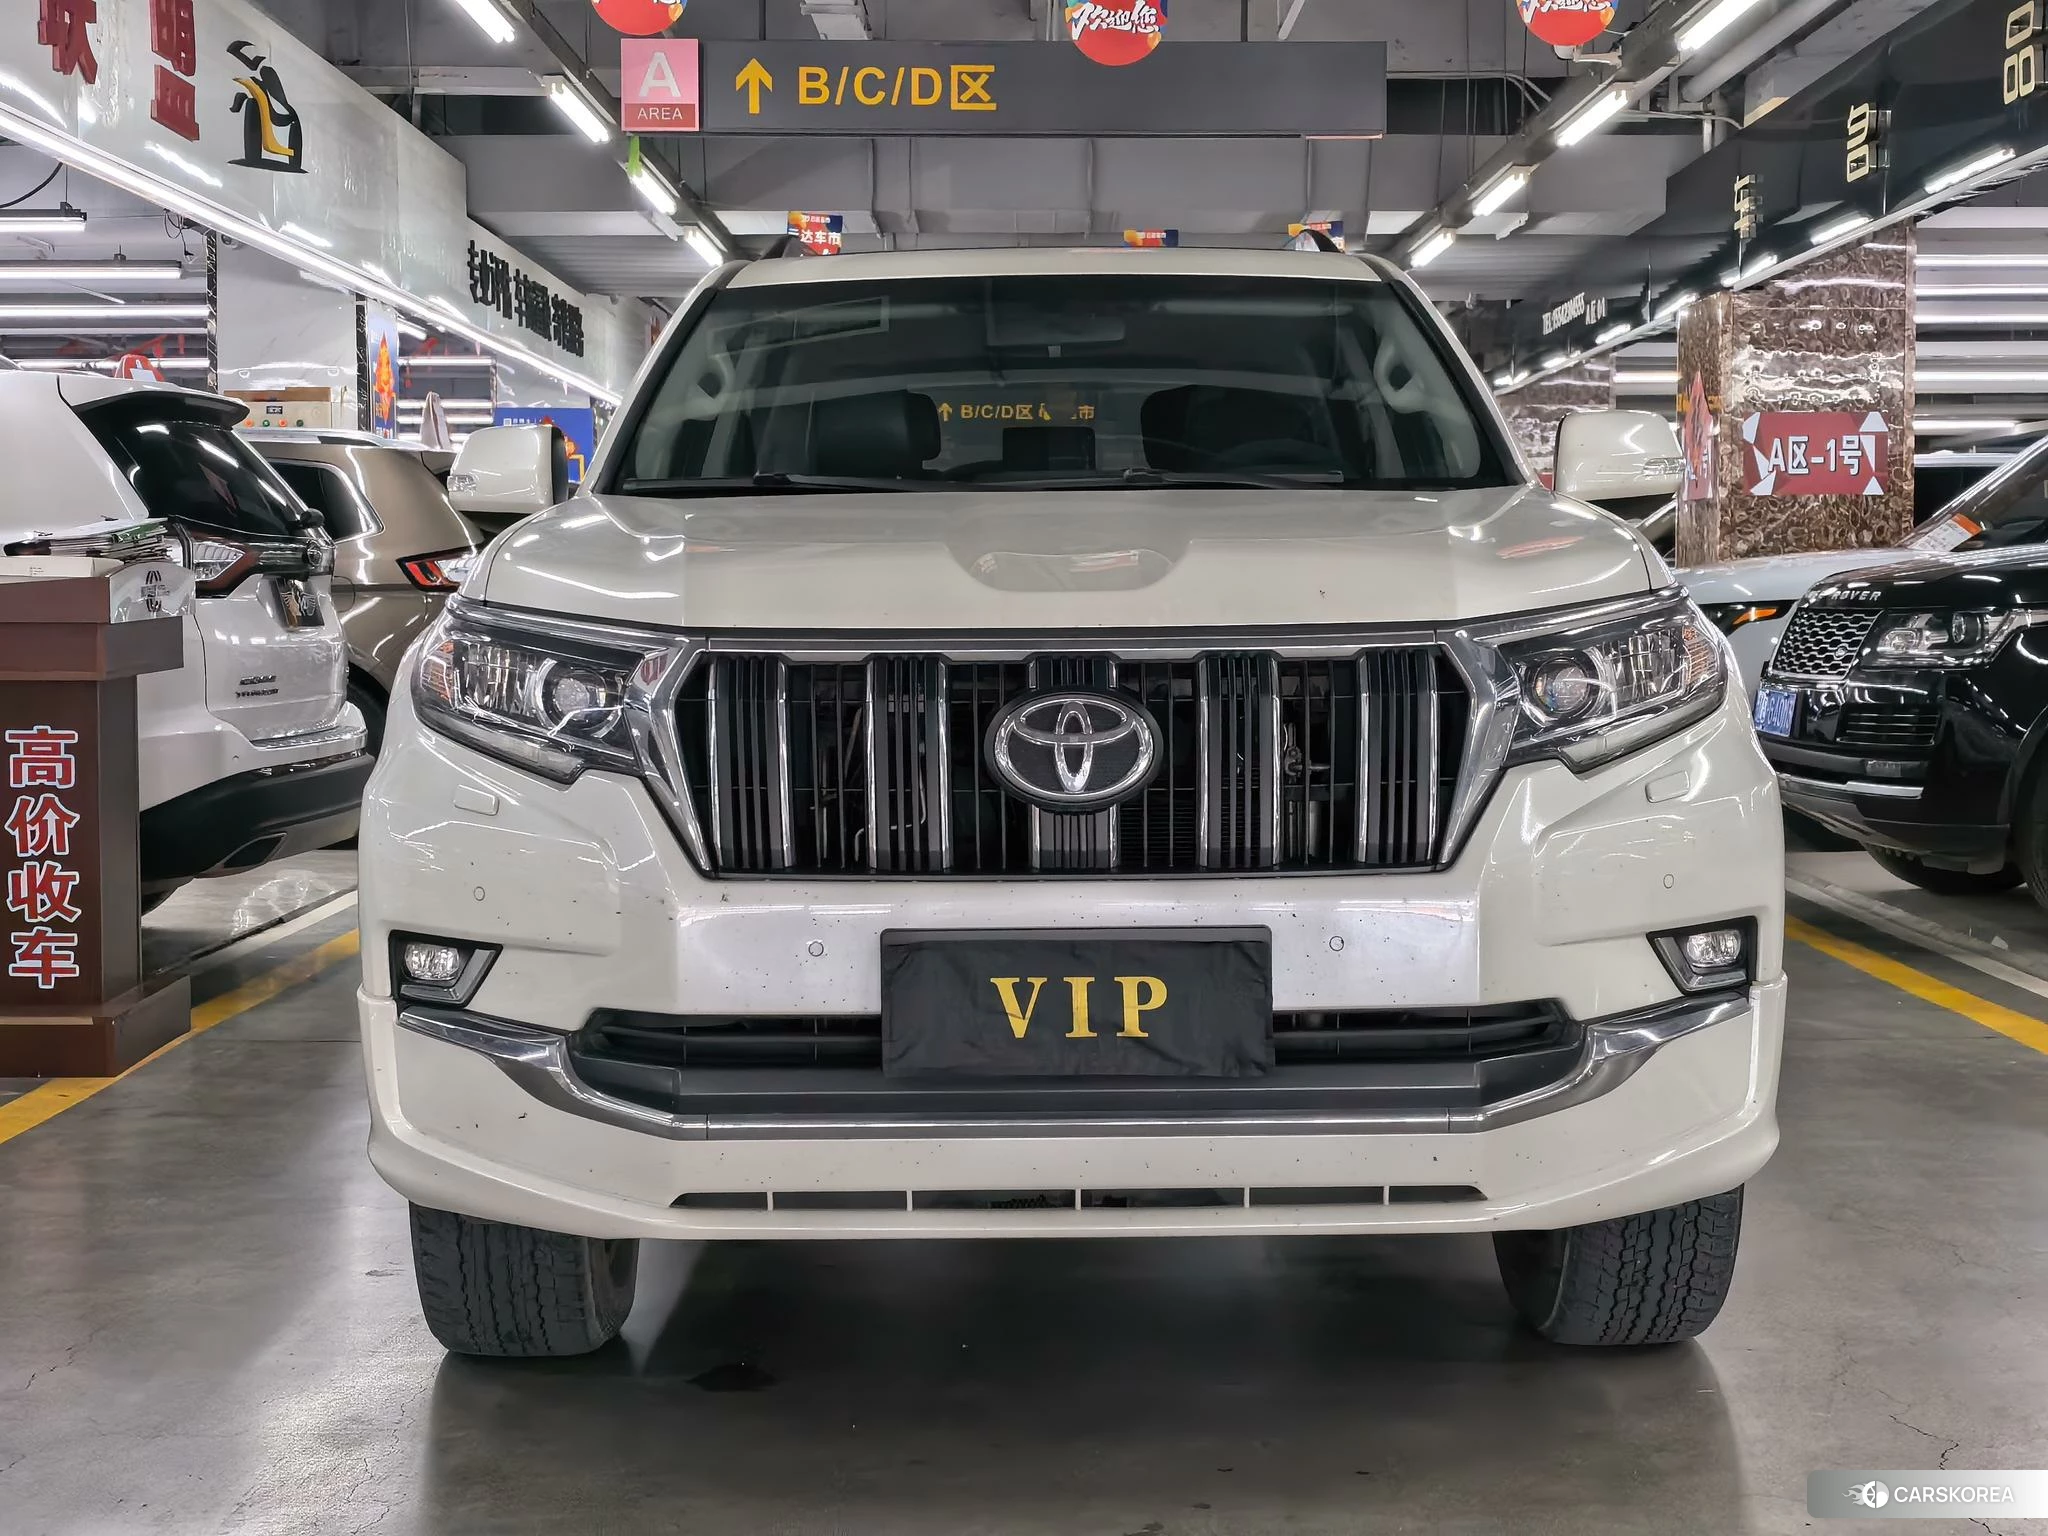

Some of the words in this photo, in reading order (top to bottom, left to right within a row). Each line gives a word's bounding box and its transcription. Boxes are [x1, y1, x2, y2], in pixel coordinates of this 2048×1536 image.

[638, 51, 681, 98] A
[798, 64, 998, 111] B/C/D区
[637, 107, 683, 121] AREA
[960, 404, 1033, 420] B/C/D区
[1768, 435, 1862, 476] A区-1号
[1831, 590, 1882, 601] ROVER
[5, 725, 81, 989] 高价收车
[990, 976, 1168, 1039] VIP
